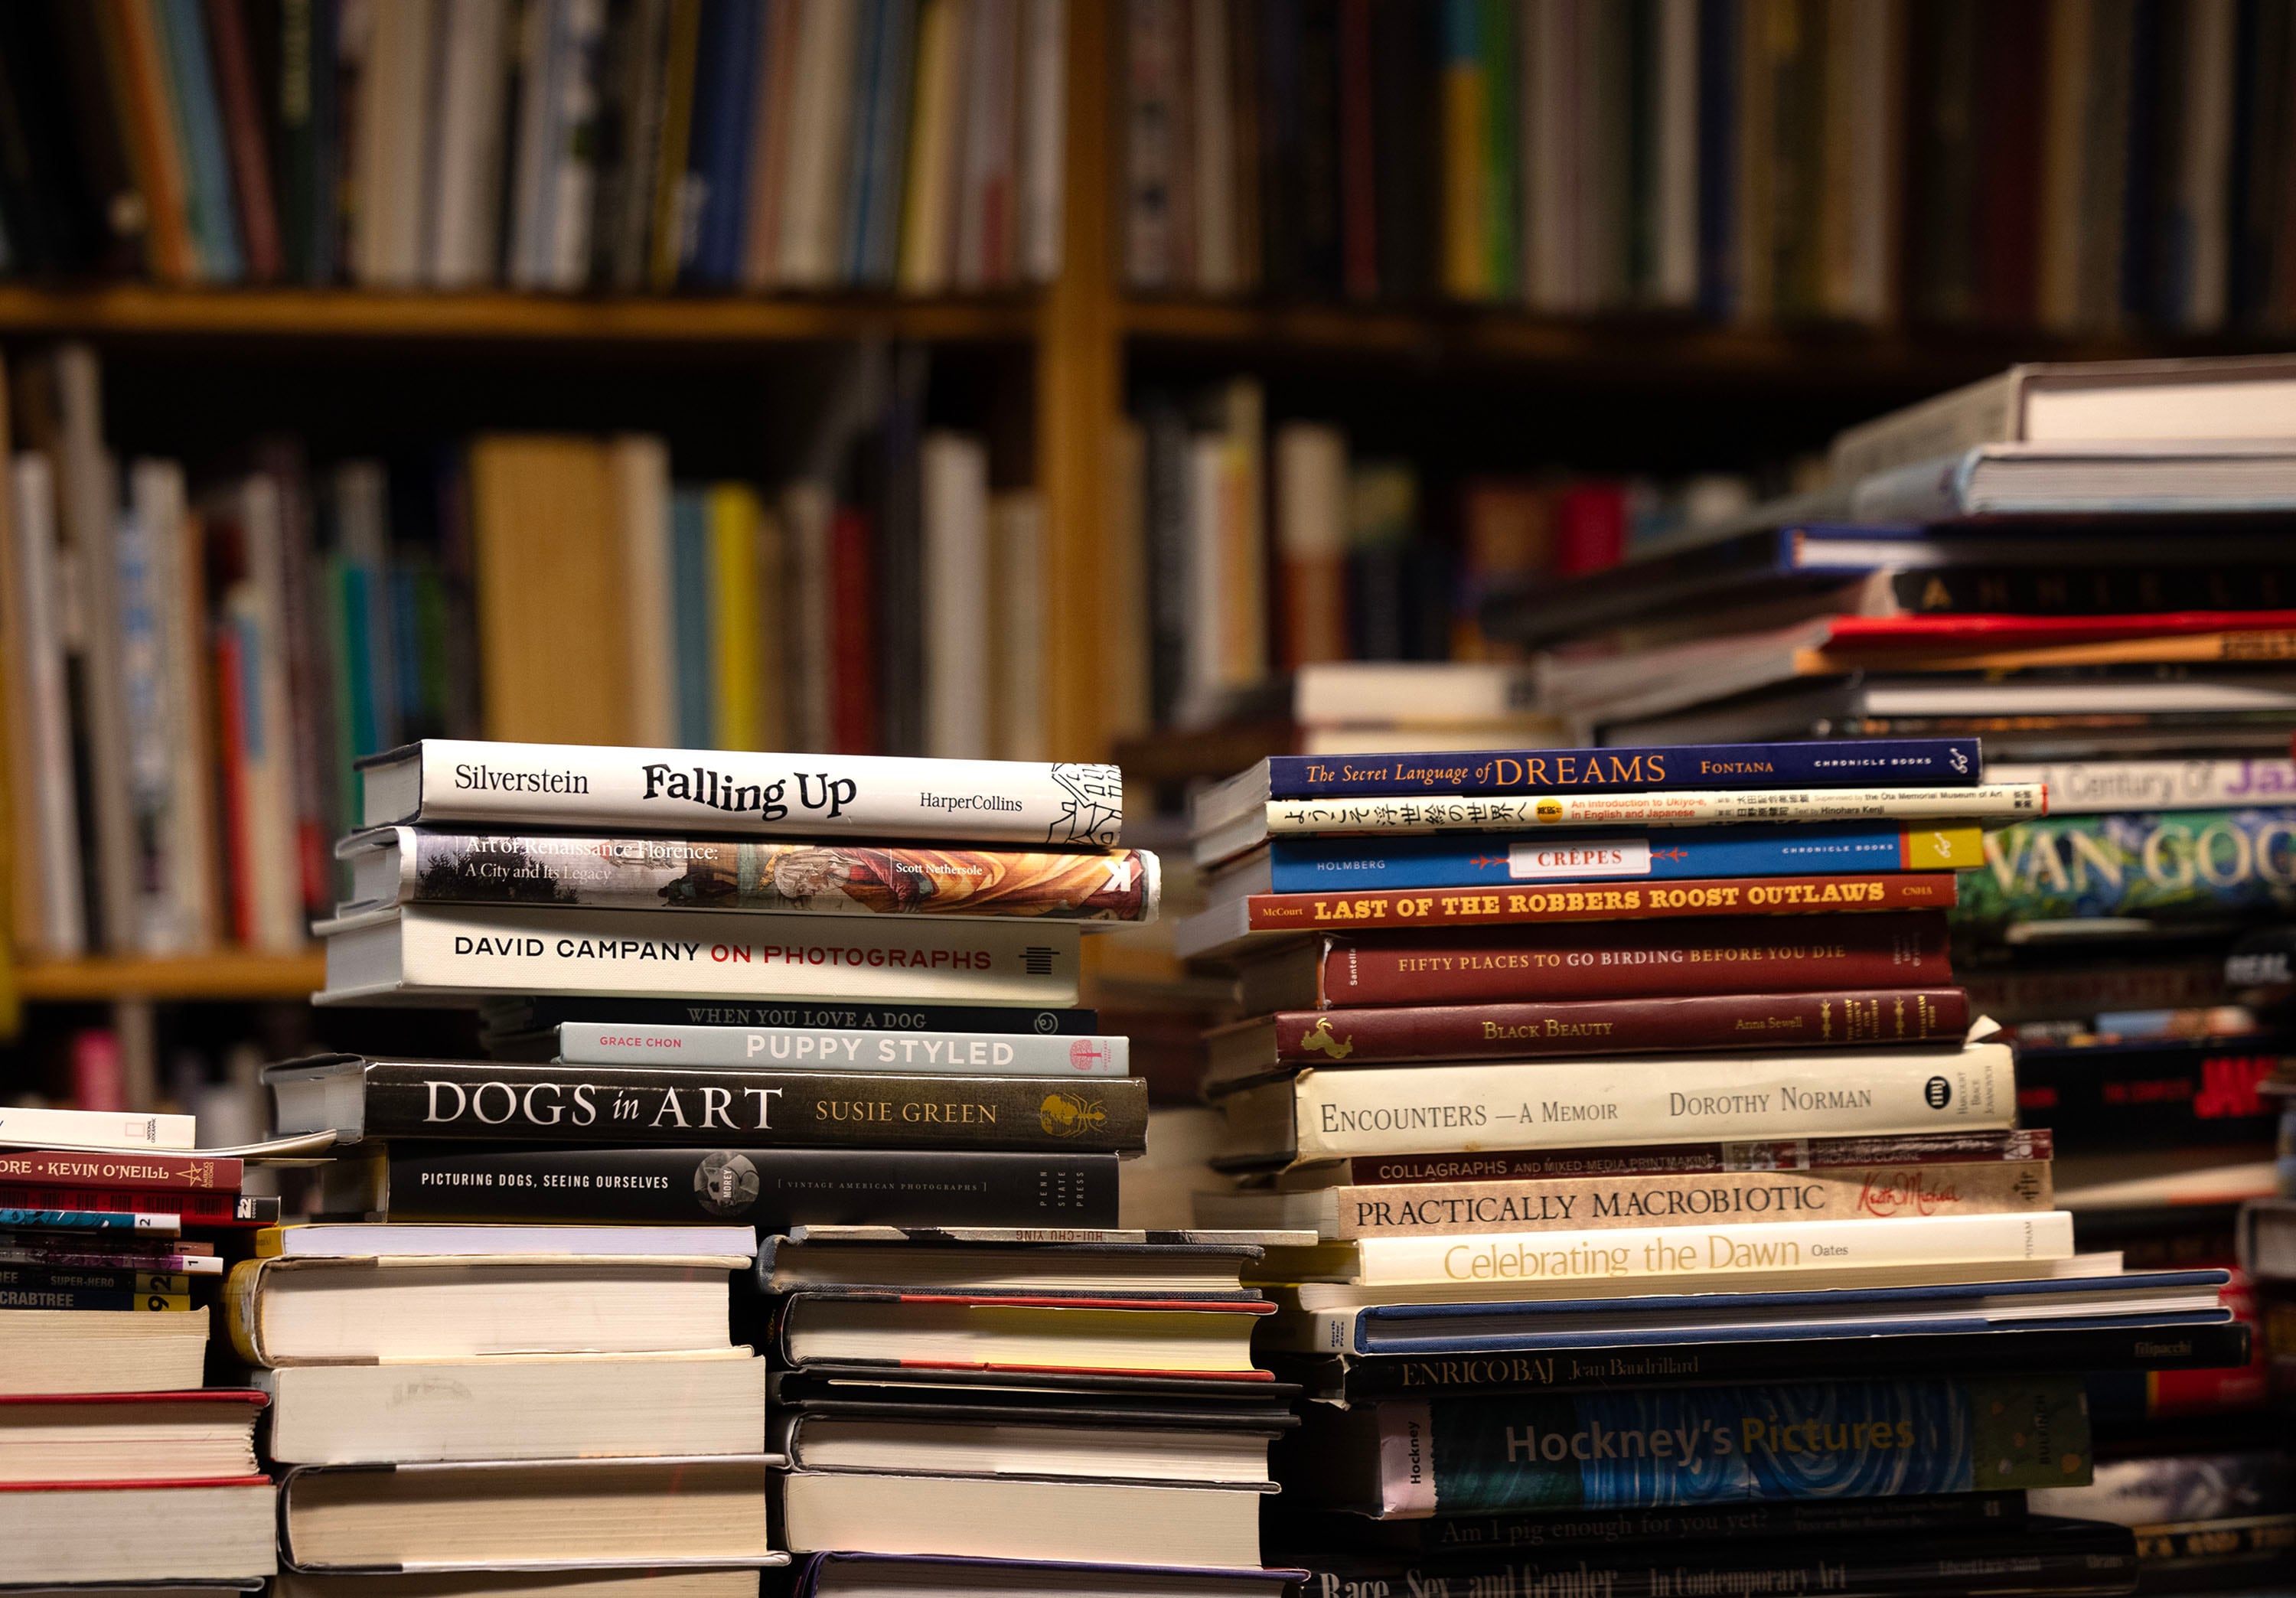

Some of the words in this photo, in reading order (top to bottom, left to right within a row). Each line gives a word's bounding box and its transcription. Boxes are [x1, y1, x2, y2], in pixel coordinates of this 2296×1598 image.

[1307, 766, 1335, 783] The
[1342, 765, 1388, 782] Secret
[1395, 763, 1469, 785] Language
[1476, 761, 1493, 784] of
[1495, 755, 1667, 786] DREAMS
[1814, 758, 1886, 768] CHRONICLE
[1892, 757, 1932, 766] BOOKS
[455, 764, 589, 794] Silverstein
[642, 763, 786, 821] Falling
[794, 772, 857, 817] Up
[920, 792, 1023, 813] HarperCollins
[1570, 799, 1586, 809] An
[1588, 797, 1650, 808] Introduction
[1652, 797, 1664, 807] to
[1666, 796, 1707, 807] Ukiyo-e,
[1898, 791, 1937, 801] Memorial
[1940, 791, 1977, 799] Museum
[1284, 801, 1528, 826] ようこそ浮世絵の世界へ
[1571, 810, 1580, 820] in
[1583, 809, 1622, 821] English
[1624, 809, 1645, 819] and
[1647, 807, 1695, 820] Japanese
[1821, 806, 1861, 815] Hinohara
[1863, 805, 1885, 815] Kenji
[465, 837, 501, 853] Art
[501, 837, 523, 854] of
[524, 839, 634, 858] Renaissance
[635, 842, 719, 860] Florence:
[1538, 846, 1623, 867] CRÊPES
[1782, 846, 1850, 854] CHRONICLE
[1855, 843, 1893, 852] BOOKS
[1985, 827, 2124, 894] VAN
[465, 864, 478, 877] A
[480, 863, 511, 882] City
[512, 865, 540, 879] and
[542, 866, 560, 880] Its
[563, 866, 612, 885] Legacy
[895, 862, 923, 875] Scott
[925, 863, 983, 876] Nethersole
[1317, 860, 1385, 871] HOLMBERG
[1263, 906, 1303, 917] McCourt
[1314, 899, 1388, 920] LAST
[1397, 898, 1433, 918] OF
[1442, 895, 1500, 915] THE
[1508, 890, 1642, 913] ROBBERS
[1649, 888, 1740, 908] ROOST
[1748, 882, 1885, 905] OUTLAWS
[455, 937, 544, 957] DAVID
[556, 938, 701, 961] CAMPANY
[711, 944, 752, 964] ON
[764, 945, 993, 970] PHOTOGRAPHS
[1398, 957, 1453, 972] FIFTY
[1459, 955, 1529, 970] PLACES
[1534, 954, 1561, 968] TO
[1566, 952, 1595, 967] GO
[1601, 950, 1684, 966] BIRDING
[1690, 947, 1765, 963] BEFORE
[1767, 946, 1806, 960] YOU
[1812, 944, 1846, 958] DIE
[1349, 947, 1358, 987] Santella
[687, 1007, 755, 1025] WHEN
[758, 1009, 797, 1026] YOU
[803, 1010, 857, 1027] LOVE
[862, 1013, 878, 1028] A
[882, 1013, 926, 1029] DOG
[1482, 1020, 1540, 1040] BLACK
[1544, 1019, 1613, 1038] BEAUTY
[1736, 1018, 1764, 1030] Anna
[1766, 1016, 1803, 1029] Sewell
[599, 1036, 644, 1048] GRACE
[646, 1037, 682, 1048] CHON
[746, 1035, 862, 1061] PUPPY
[879, 1039, 1014, 1066] STYLED
[1670, 1092, 1769, 1117] DOROTHY
[1781, 1086, 1872, 1111] NORMAN
[1930, 1079, 1945, 1106] HBJ
[1957, 1072, 1968, 1114] HARCOURT
[1971, 1078, 1981, 1106] BRACE
[422, 1080, 597, 1126] DOGS
[612, 1090, 640, 1120] in
[649, 1085, 783, 1130] ART
[816, 1100, 892, 1121] SUSIE
[902, 1102, 998, 1124] GREEN
[1321, 1104, 1487, 1133] ENCOUNTERS
[1542, 1100, 1618, 1123] MEMOIR
[47, 1162, 99, 1178] KEVIN
[103, 1163, 170, 1179] O'NEILL
[1380, 1160, 1508, 1179] COLLAGRAPHS
[1515, 1161, 1541, 1173] AND
[1544, 1157, 1627, 1172] MIXED-MEDIA
[1630, 1153, 1715, 1169] PRINTMAKING
[421, 1172, 493, 1186] PICTURING
[498, 1174, 537, 1189] DOGS,
[543, 1175, 590, 1188] SEEING
[595, 1175, 669, 1189] OURSELVES
[723, 1168, 732, 1198] MOREY
[787, 1181, 833, 1190] VINTAGE
[839, 1182, 895, 1191] AMERICAN
[901, 1182, 978, 1192] PHOTOGRAPHS
[1076, 1171, 1084, 1208] PRESS
[1356, 1195, 1577, 1226] PRACTICALLY
[1592, 1185, 1825, 1218] MACROBIOTIC
[139, 1218, 151, 1227] 2
[1015, 1230, 1043, 1241] YING
[1049, 1231, 1104, 1241] HUI-CHU
[1444, 1241, 1630, 1280] Celebrating
[1643, 1237, 1697, 1272] the
[1708, 1234, 1800, 1269] Dawn
[1812, 1243, 1849, 1257] Oates
[51, 1275, 114, 1287] SUPER-HERO
[150, 1276, 172, 1293] 2
[0, 1290, 73, 1307] CRABTREE
[1403, 1360, 1509, 1386] ENRICO
[1513, 1358, 1554, 1384] BAJ
[1569, 1359, 1604, 1381] Jean
[1609, 1355, 1699, 1377] Baudrillard
[1411, 1420, 1421, 1484] Hockney
[1506, 1419, 1732, 1467] Hockney's
[1741, 1417, 1915, 1454] Pictures
[1441, 1525, 1482, 1544] Am
[1509, 1521, 1544, 1545] pig
[1552, 1517, 1629, 1543] enough
[1641, 1515, 1671, 1536] for
[1681, 1515, 1719, 1538] you
[1469, 1565, 1513, 1598] and
[1521, 1561, 1619, 1598] Gender
[1649, 1567, 1671, 1597] In
[1675, 1565, 1808, 1598] Contemporary
[1818, 1560, 1846, 1590] Art
